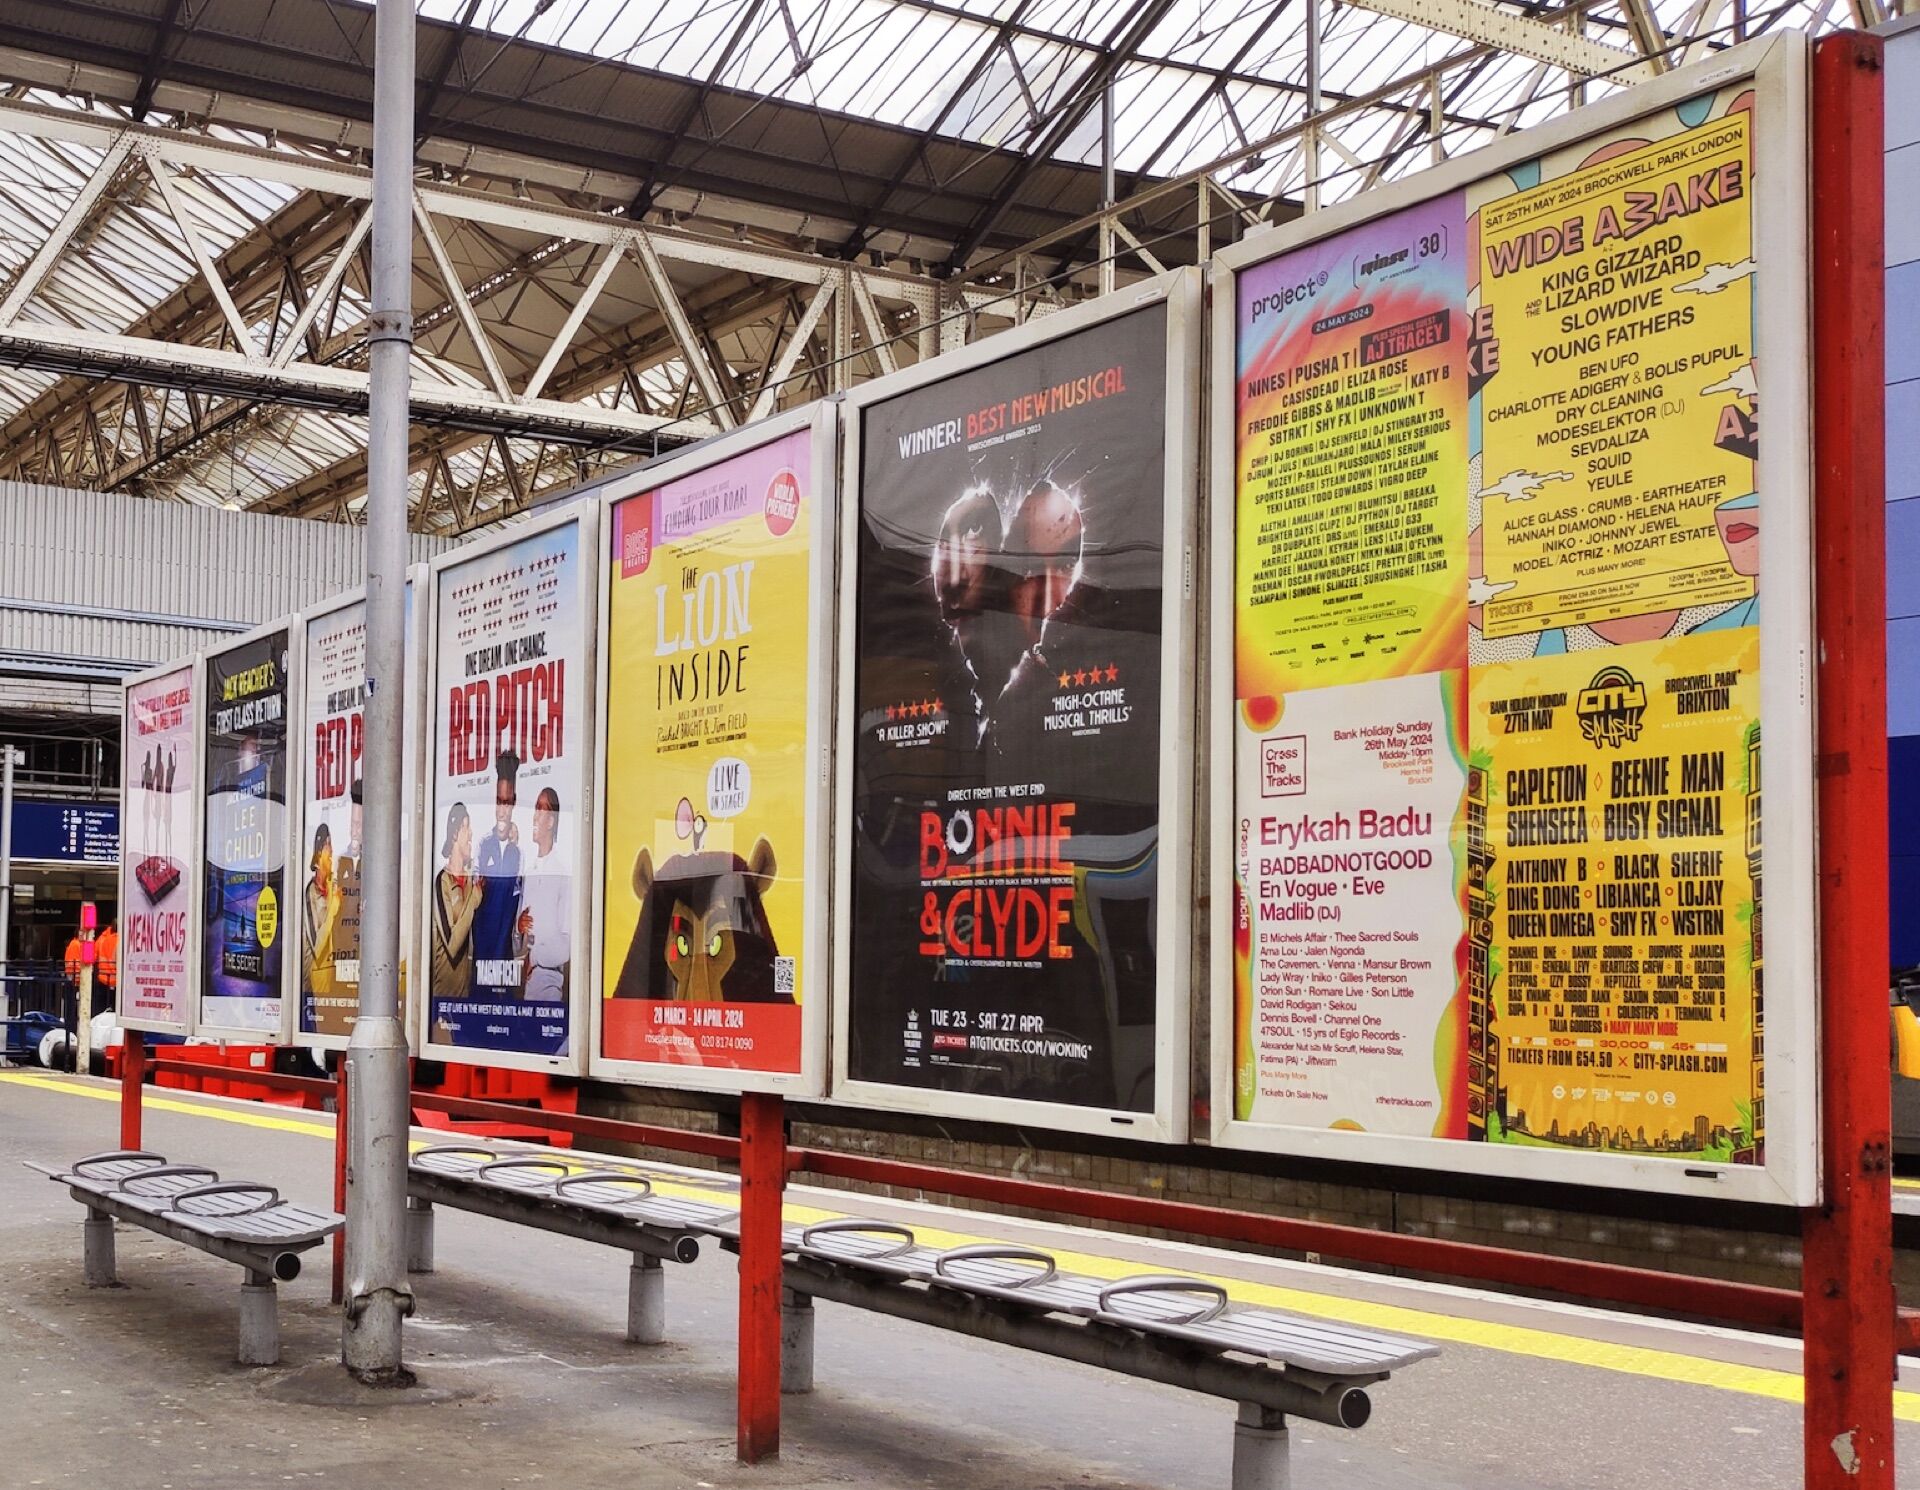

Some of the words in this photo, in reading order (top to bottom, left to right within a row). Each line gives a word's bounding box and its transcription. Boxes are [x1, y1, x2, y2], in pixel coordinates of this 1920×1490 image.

[1485, 213, 1504, 228] SAT
[1506, 206, 1531, 222] 25TH
[1534, 195, 1556, 212] MAY
[1559, 187, 1582, 202] 2024
[1584, 161, 1654, 194] BROCKWELL
[1657, 147, 1688, 169] PARK
[1691, 129, 1743, 156] LONDON
[1486, 215, 1584, 279] WIDE
[1542, 265, 1589, 293] KING
[1595, 235, 1683, 277] GIZZARD
[1545, 277, 1615, 313] LIZARD
[1621, 250, 1701, 289] WIZARD
[1315, 319, 1326, 331] 24
[1328, 313, 1346, 328] MAY
[1349, 306, 1369, 322] 2024
[1561, 290, 1663, 334] SLOWDIVE
[1366, 341, 1384, 363] AJ
[1387, 323, 1443, 356] TRACEY
[1531, 334, 1600, 368] YOUNG
[1606, 306, 1695, 347] FATHERS
[1248, 373, 1285, 399] NINES
[1296, 357, 1339, 384] PUSHA
[1342, 352, 1350, 368] T
[1580, 363, 1607, 380] BEN
[1611, 352, 1639, 372] UFO
[1282, 380, 1339, 408] CASISDEAD
[1347, 370, 1376, 389] ELIZA
[1379, 359, 1408, 380] ROSE
[899, 418, 962, 459] WINNER!
[967, 403, 1006, 438] BEST
[1012, 390, 1048, 424] NEW
[1051, 366, 1126, 414] MUSICAL
[1248, 412, 1288, 435] FREDDIE
[1291, 403, 1322, 423] GIBBS
[1325, 400, 1333, 413] &
[1336, 387, 1376, 409] MADLIB
[1411, 368, 1438, 388] KATY
[1442, 365, 1449, 379] B
[1570, 428, 1649, 458] SEVDALIZA
[1588, 451, 1632, 473] SQUID
[1587, 470, 1633, 493] YEULE
[682, 566, 698, 591] THE
[1292, 584, 1321, 599] SIMONE
[1421, 560, 1448, 574] TASHA
[655, 560, 755, 656] LION
[657, 645, 749, 710] INSIDE
[1677, 688, 1730, 715] BRIXTON
[449, 680, 491, 776] RED
[496, 659, 565, 765] PITCH
[1044, 710, 1086, 731] MUSICAL
[1334, 730, 1358, 741] Bank
[1360, 725, 1393, 739] Holiday
[1396, 721, 1433, 736] Sunday
[1504, 712, 1529, 734] 27TH
[1532, 709, 1553, 730] MAY
[1364, 738, 1385, 751] 26th
[1387, 736, 1408, 750] May
[1410, 734, 1433, 745] 2024
[316, 717, 346, 800] RED
[1266, 762, 1286, 774] The
[714, 763, 741, 793] LIVE
[948, 789, 971, 801] DIRECT
[995, 786, 1008, 798] THE
[1009, 784, 1028, 798] WEST
[1030, 783, 1045, 796] END
[1266, 774, 1301, 787] Tracks
[1507, 764, 1587, 807] CAPLETON
[1611, 756, 1670, 799] BEENIE
[1681, 751, 1724, 794] MAN
[234, 806, 256, 831] LEE
[1260, 806, 1351, 851] Erykah
[1359, 806, 1432, 840] Badu
[1507, 806, 1588, 847] SHENSEEA
[1604, 801, 1651, 842] BUSY
[1657, 796, 1724, 839] SIGNAL
[225, 831, 263, 870] CHILD
[919, 802, 1077, 879] BONNIE
[1260, 849, 1432, 876] BADBADNOTGOOD
[1507, 858, 1567, 884] ANTHONY
[1578, 857, 1587, 881] B
[1614, 854, 1660, 880] BLACK
[1671, 851, 1724, 878] SHERIF
[1260, 881, 1280, 898] En
[1284, 878, 1337, 901] Vogue
[1352, 876, 1385, 895] Eve
[1507, 886, 1538, 911] DING
[1543, 885, 1580, 910] DONG
[1596, 882, 1661, 909] LIBIANCA
[1677, 880, 1724, 907] LOJAY
[945, 887, 1074, 958] CLYDE
[1260, 902, 1314, 921] Madlib
[1317, 905, 1341, 923] (DJ)
[1270, 932, 1303, 943] Michels
[1305, 932, 1327, 942] Affair
[1335, 932, 1357, 942] Thee
[1359, 932, 1391, 942] Sacred
[1393, 931, 1419, 942] Souls
[1260, 973, 1280, 984] Lady
[1282, 973, 1304, 984] Wray
[1366, 973, 1407, 983] Peterson
[930, 1009, 949, 1027] TUE
[953, 1011, 967, 1028] 23
[978, 1012, 998, 1029] SAT
[1000, 1014, 1016, 1030] 27
[1020, 1015, 1044, 1033] APR
[1507, 1048, 1544, 1065] TICKETS
[1547, 1049, 1573, 1066] FROM
[1633, 1053, 1728, 1073] CITY-SPLASH.COM
